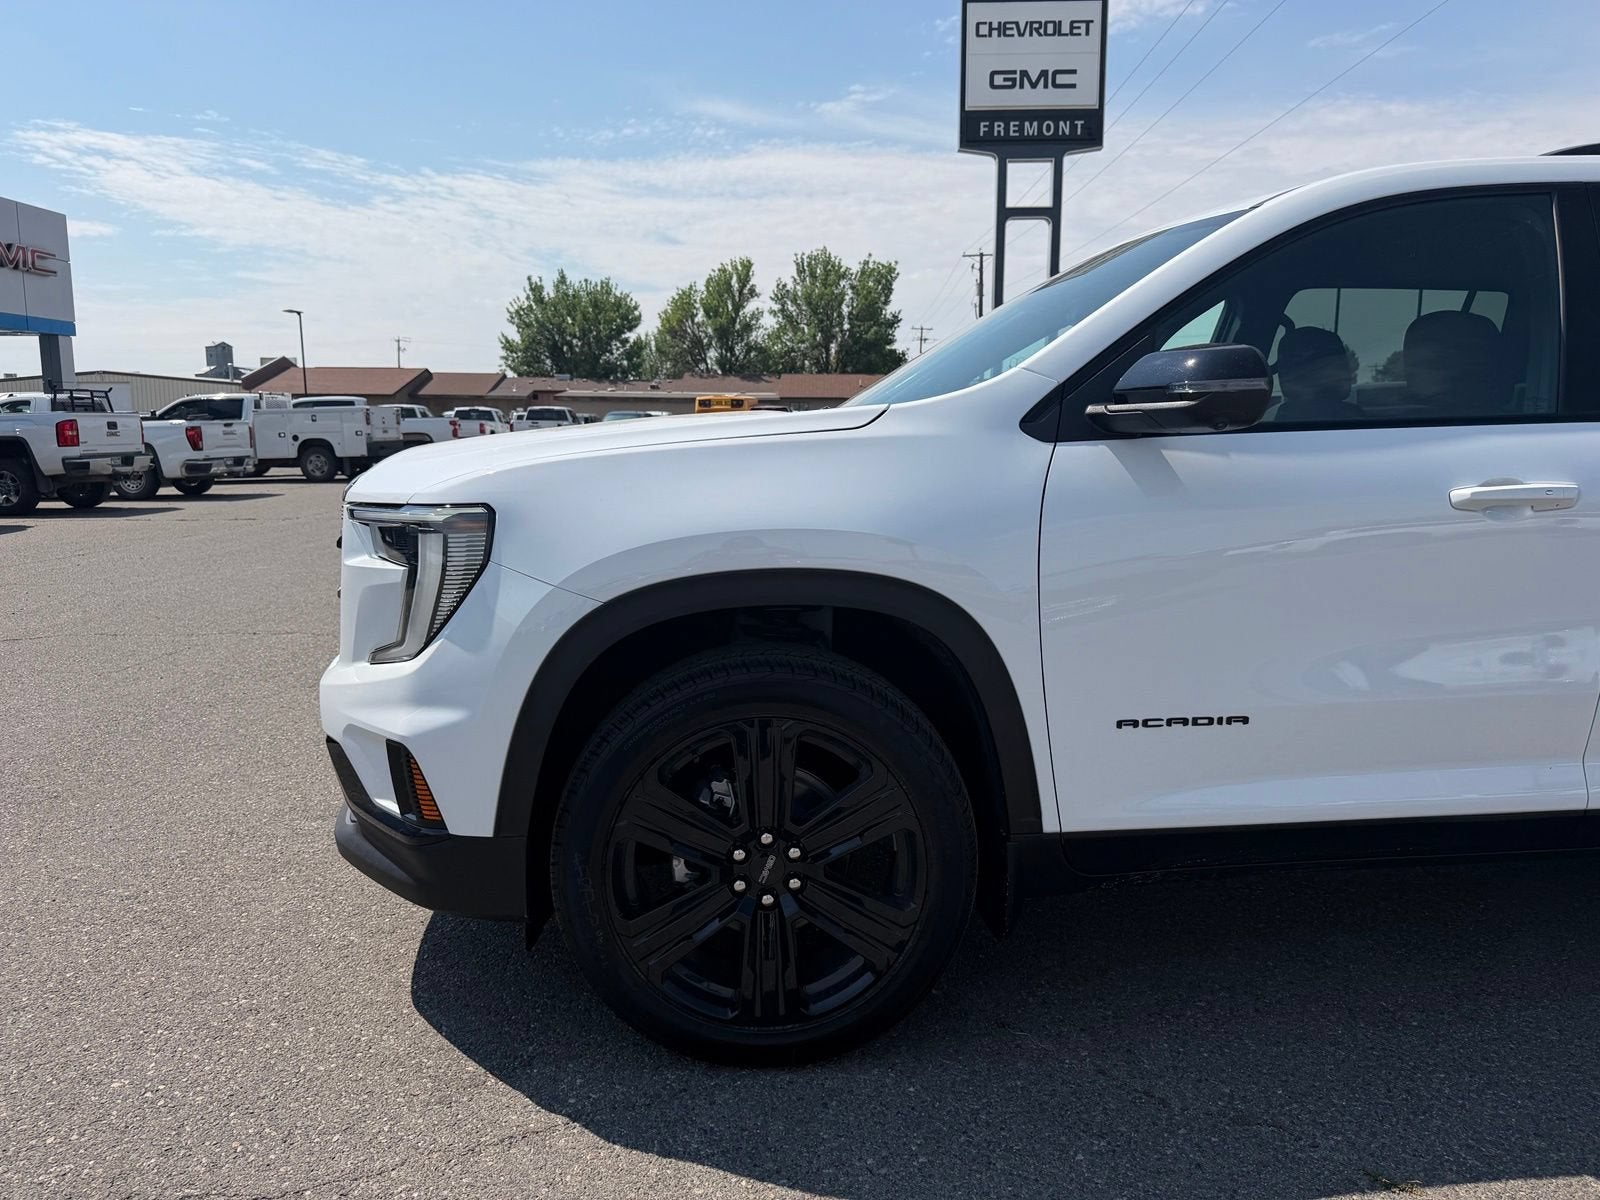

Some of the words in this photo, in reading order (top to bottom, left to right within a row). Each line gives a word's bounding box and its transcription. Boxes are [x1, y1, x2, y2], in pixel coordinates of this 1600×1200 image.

[975, 19, 1094, 38] CHEVROLET
[989, 69, 1078, 90] GMC
[979, 120, 1085, 137] FREMONT
[1116, 715, 1250, 730] ACADIA
